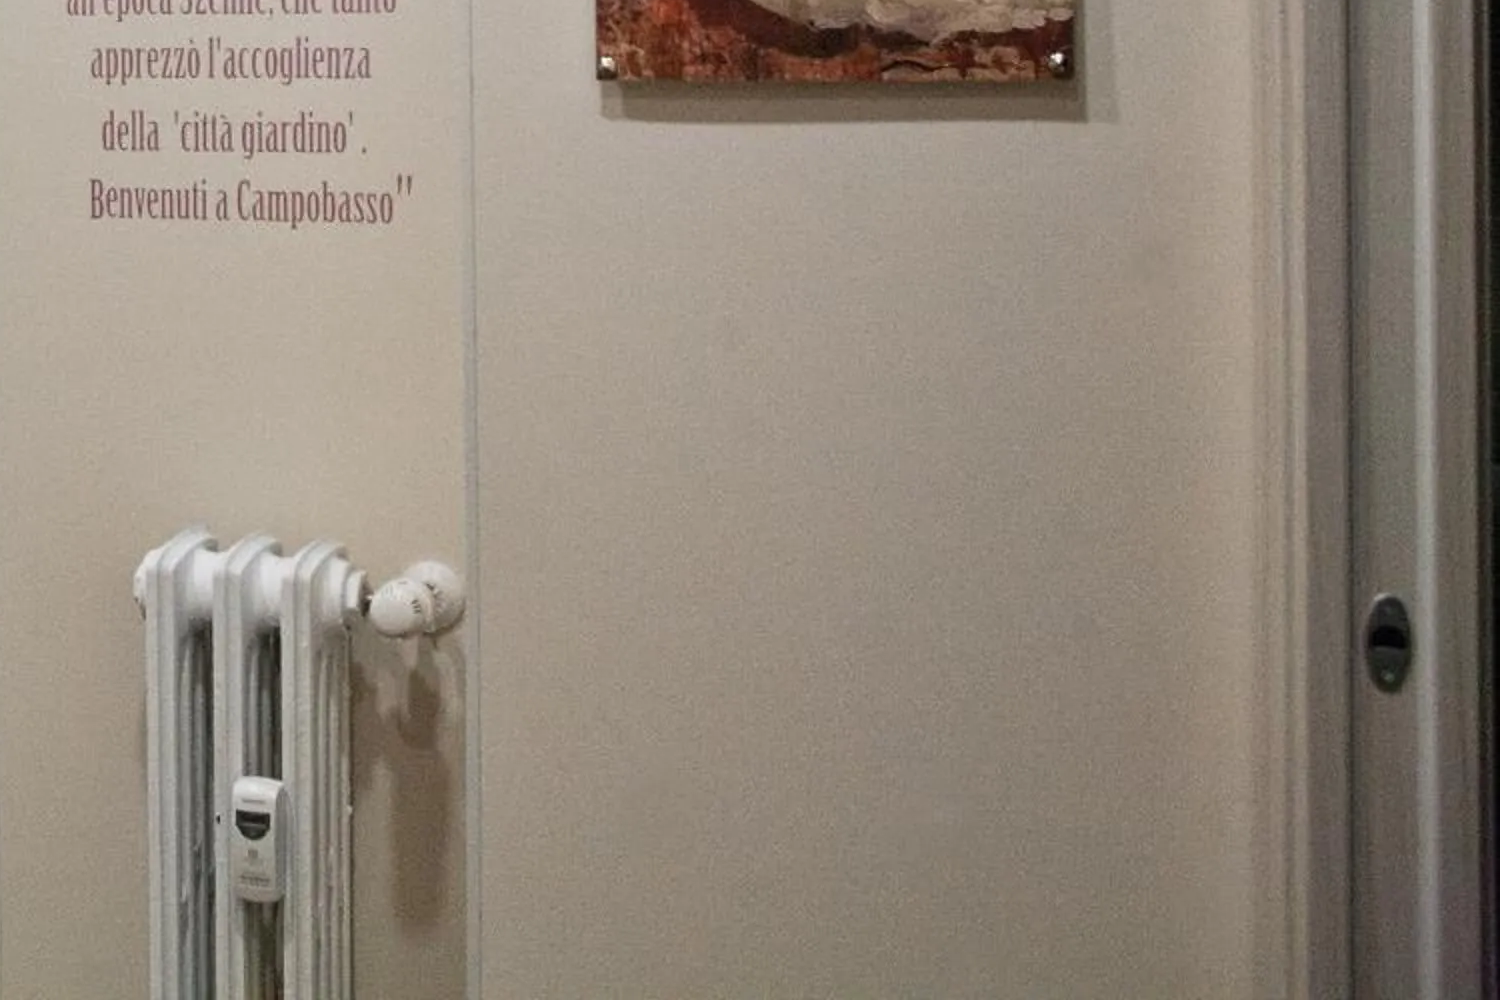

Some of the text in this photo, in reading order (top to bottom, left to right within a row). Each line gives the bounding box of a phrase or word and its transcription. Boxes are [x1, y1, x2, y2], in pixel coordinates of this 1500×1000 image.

[90, 36, 372, 86] apprezzò l'accoglienza
[101, 109, 160, 152] della
[89, 178, 208, 221] Benvenuti
[215, 189, 230, 222] a
